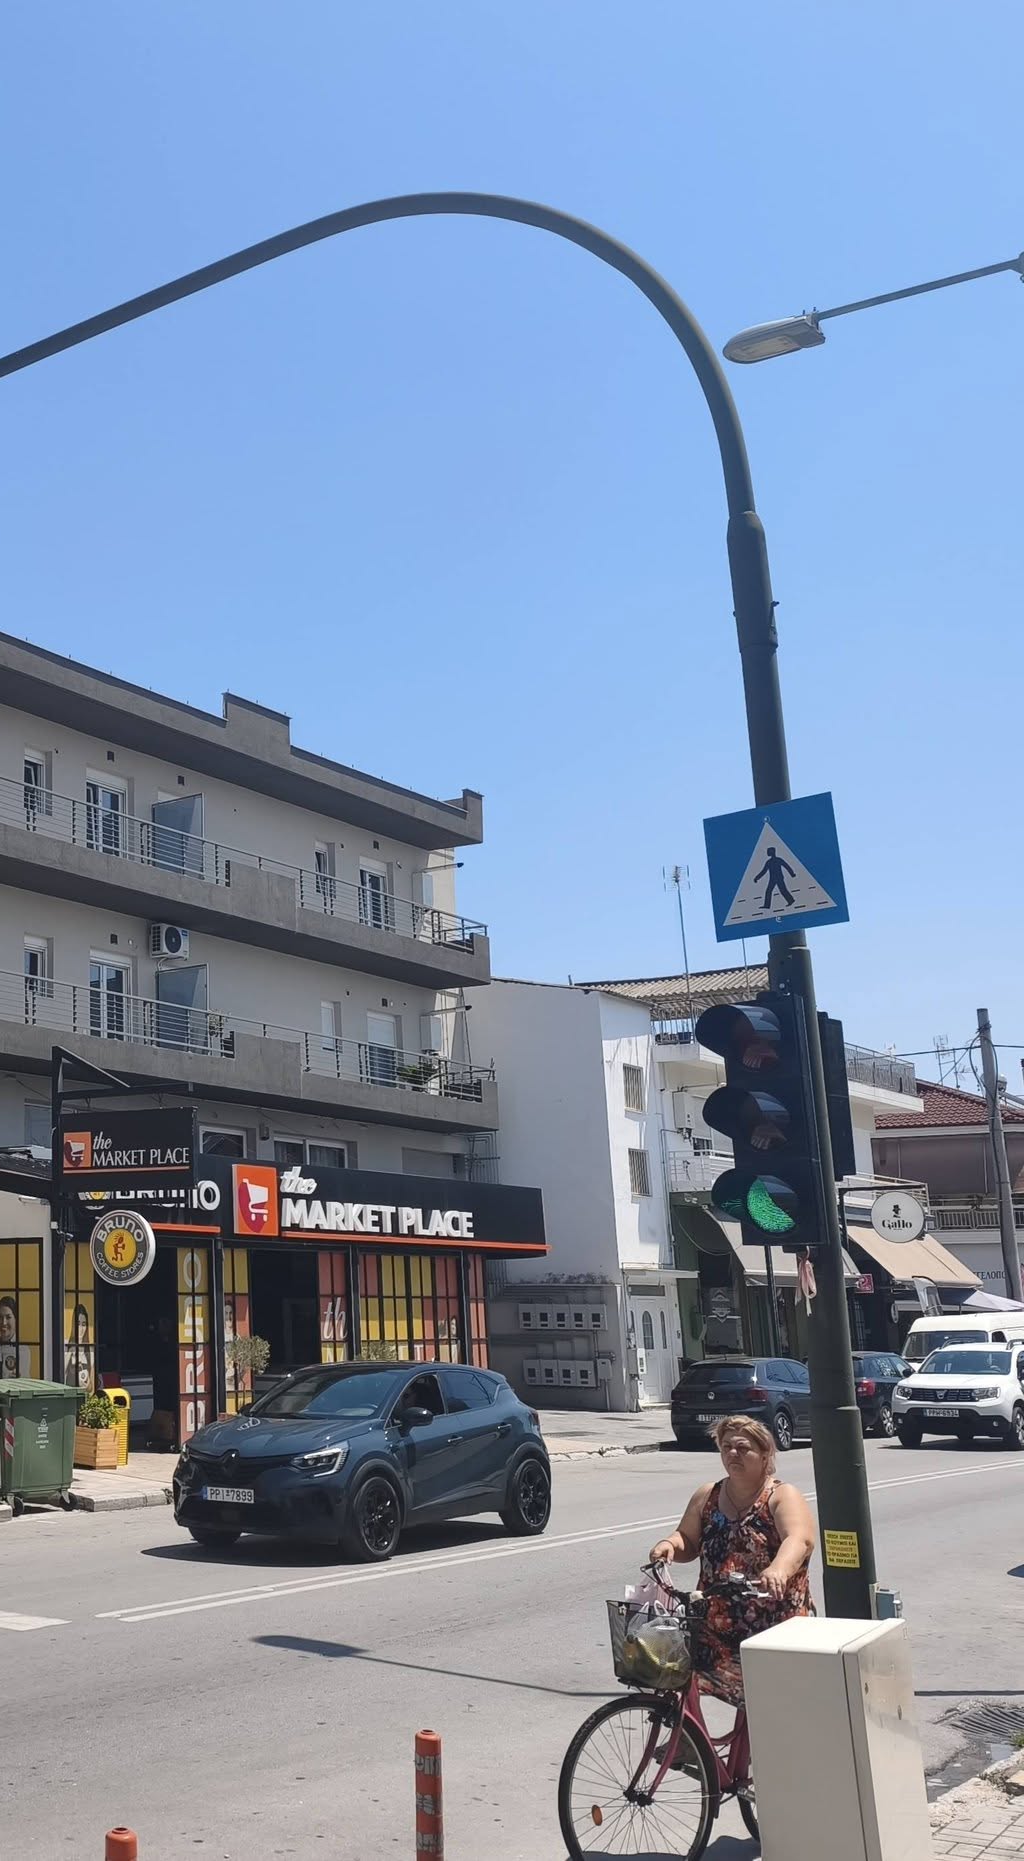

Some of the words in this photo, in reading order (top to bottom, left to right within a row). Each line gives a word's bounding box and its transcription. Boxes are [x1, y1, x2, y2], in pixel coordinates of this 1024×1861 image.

[92, 1131, 112, 1150] the
[92, 1149, 146, 1167] MARKET
[150, 1147, 190, 1165] PLACE
[280, 1166, 317, 1195] the
[96, 1216, 144, 1242] BRUNO
[281, 1198, 396, 1234] MARKET
[398, 1206, 475, 1238] PLACE
[882, 1218, 912, 1230] Gallo
[96, 1252, 119, 1278] COFFEE
[121, 1252, 144, 1278] STORES
